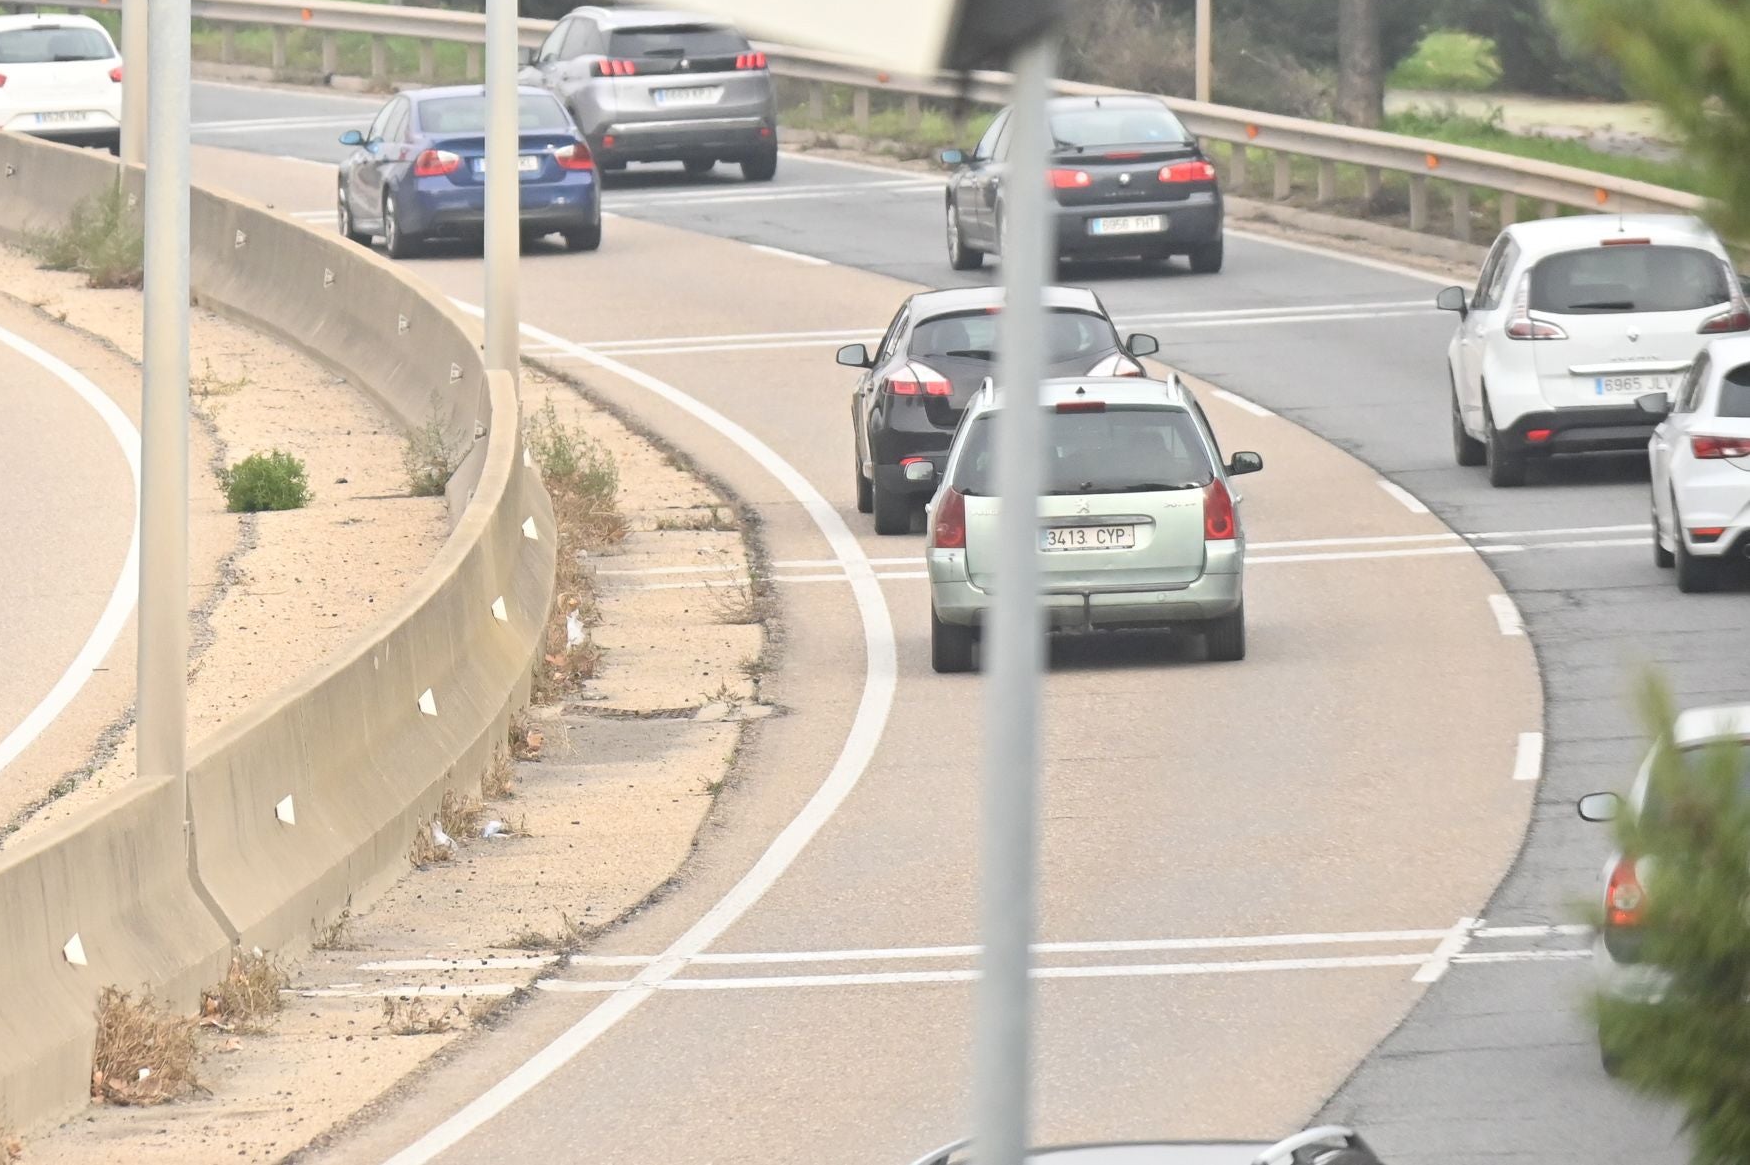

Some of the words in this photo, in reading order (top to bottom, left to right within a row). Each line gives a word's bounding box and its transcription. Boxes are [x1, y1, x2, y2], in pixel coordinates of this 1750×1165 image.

[1604, 377, 1643, 392] 6965
[1648, 376, 1674, 390] JLV
[1048, 529, 1086, 546] 3413
[1096, 528, 1125, 545] CYP
